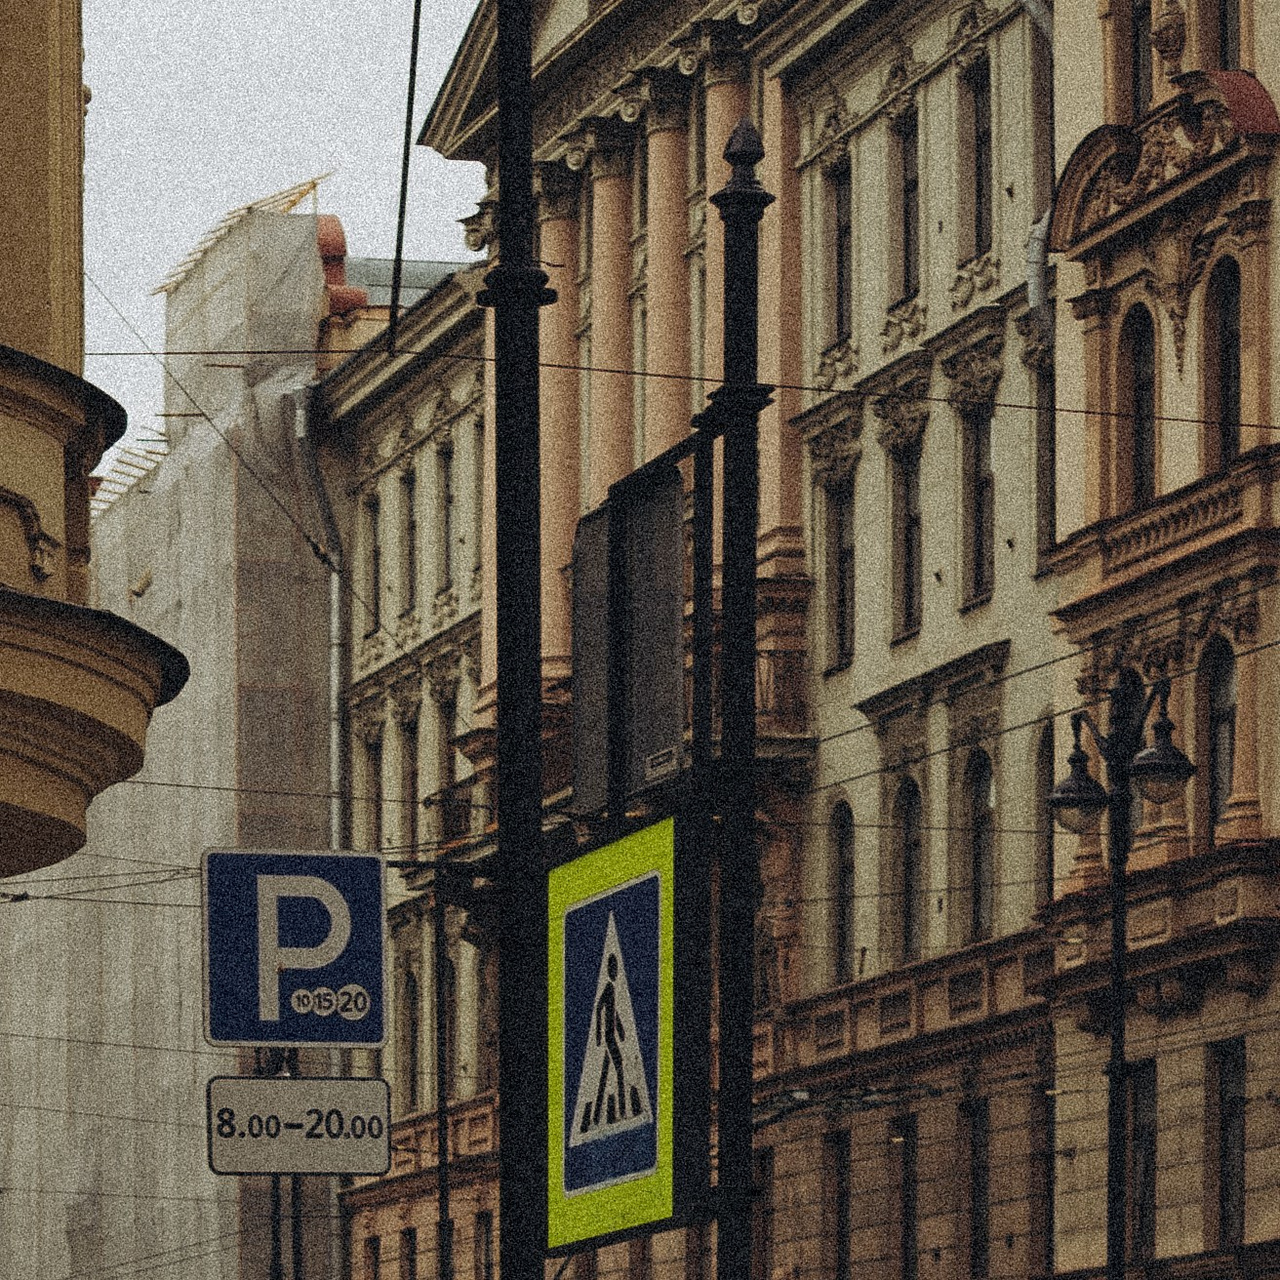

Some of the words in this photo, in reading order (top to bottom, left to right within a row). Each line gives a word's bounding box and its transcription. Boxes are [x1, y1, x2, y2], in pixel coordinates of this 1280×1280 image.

[256, 874, 352, 1022] P
[314, 992, 333, 1010] 15
[340, 991, 368, 1012] 20
[217, 1107, 383, 1139] 8.00-20.00
